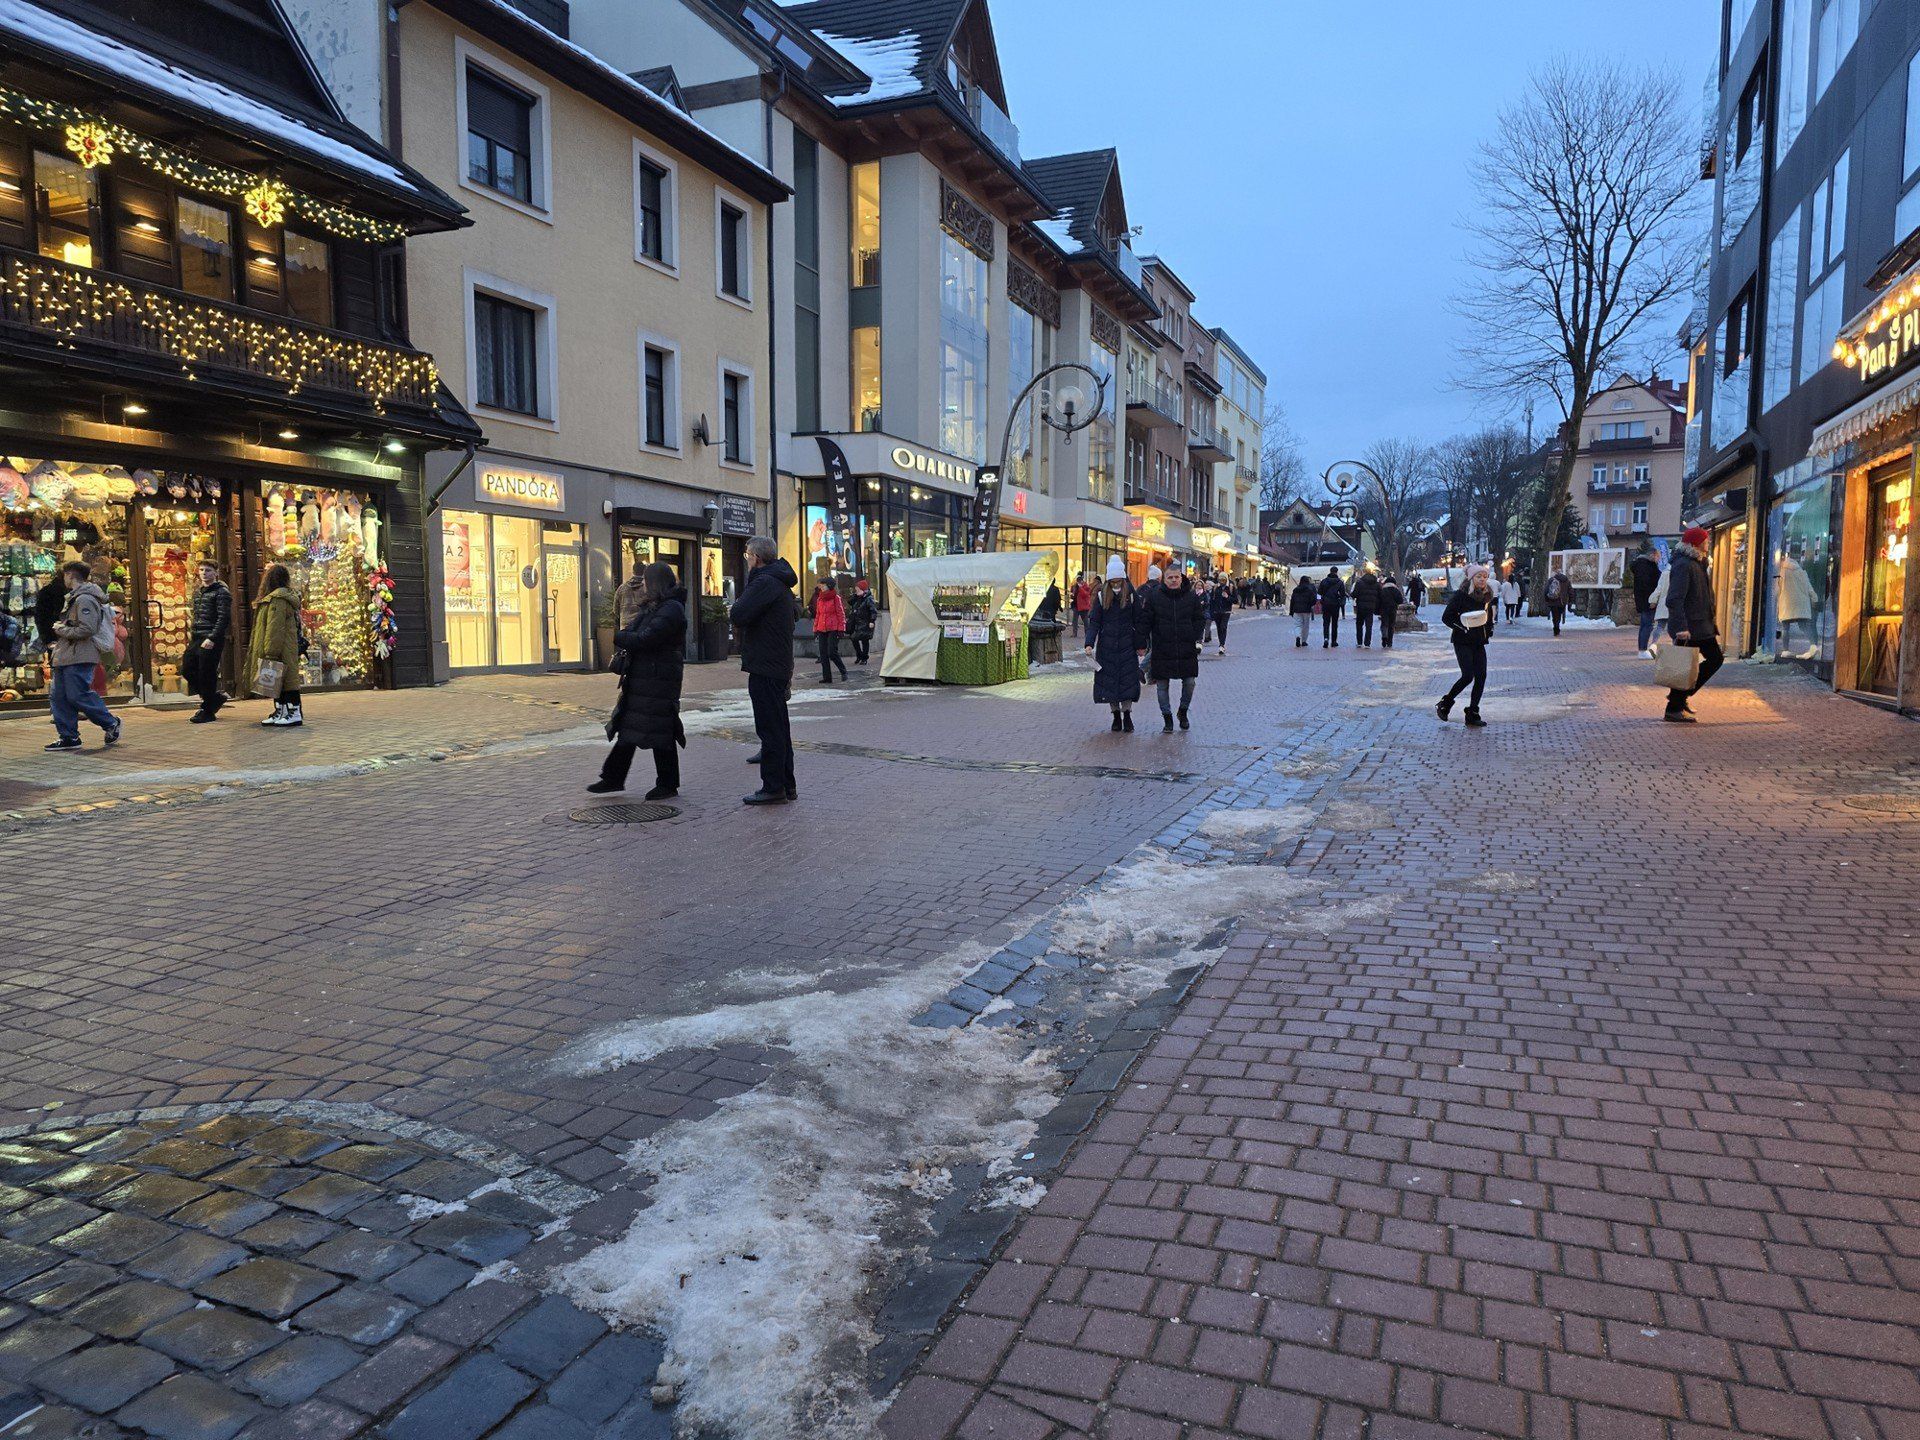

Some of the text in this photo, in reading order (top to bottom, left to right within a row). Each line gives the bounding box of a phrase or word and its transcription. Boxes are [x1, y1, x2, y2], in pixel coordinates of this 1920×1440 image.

[915, 454, 971, 484] OAKLEY
[486, 473, 560, 500] PANDORA
[831, 455, 851, 540] OAKLEY
